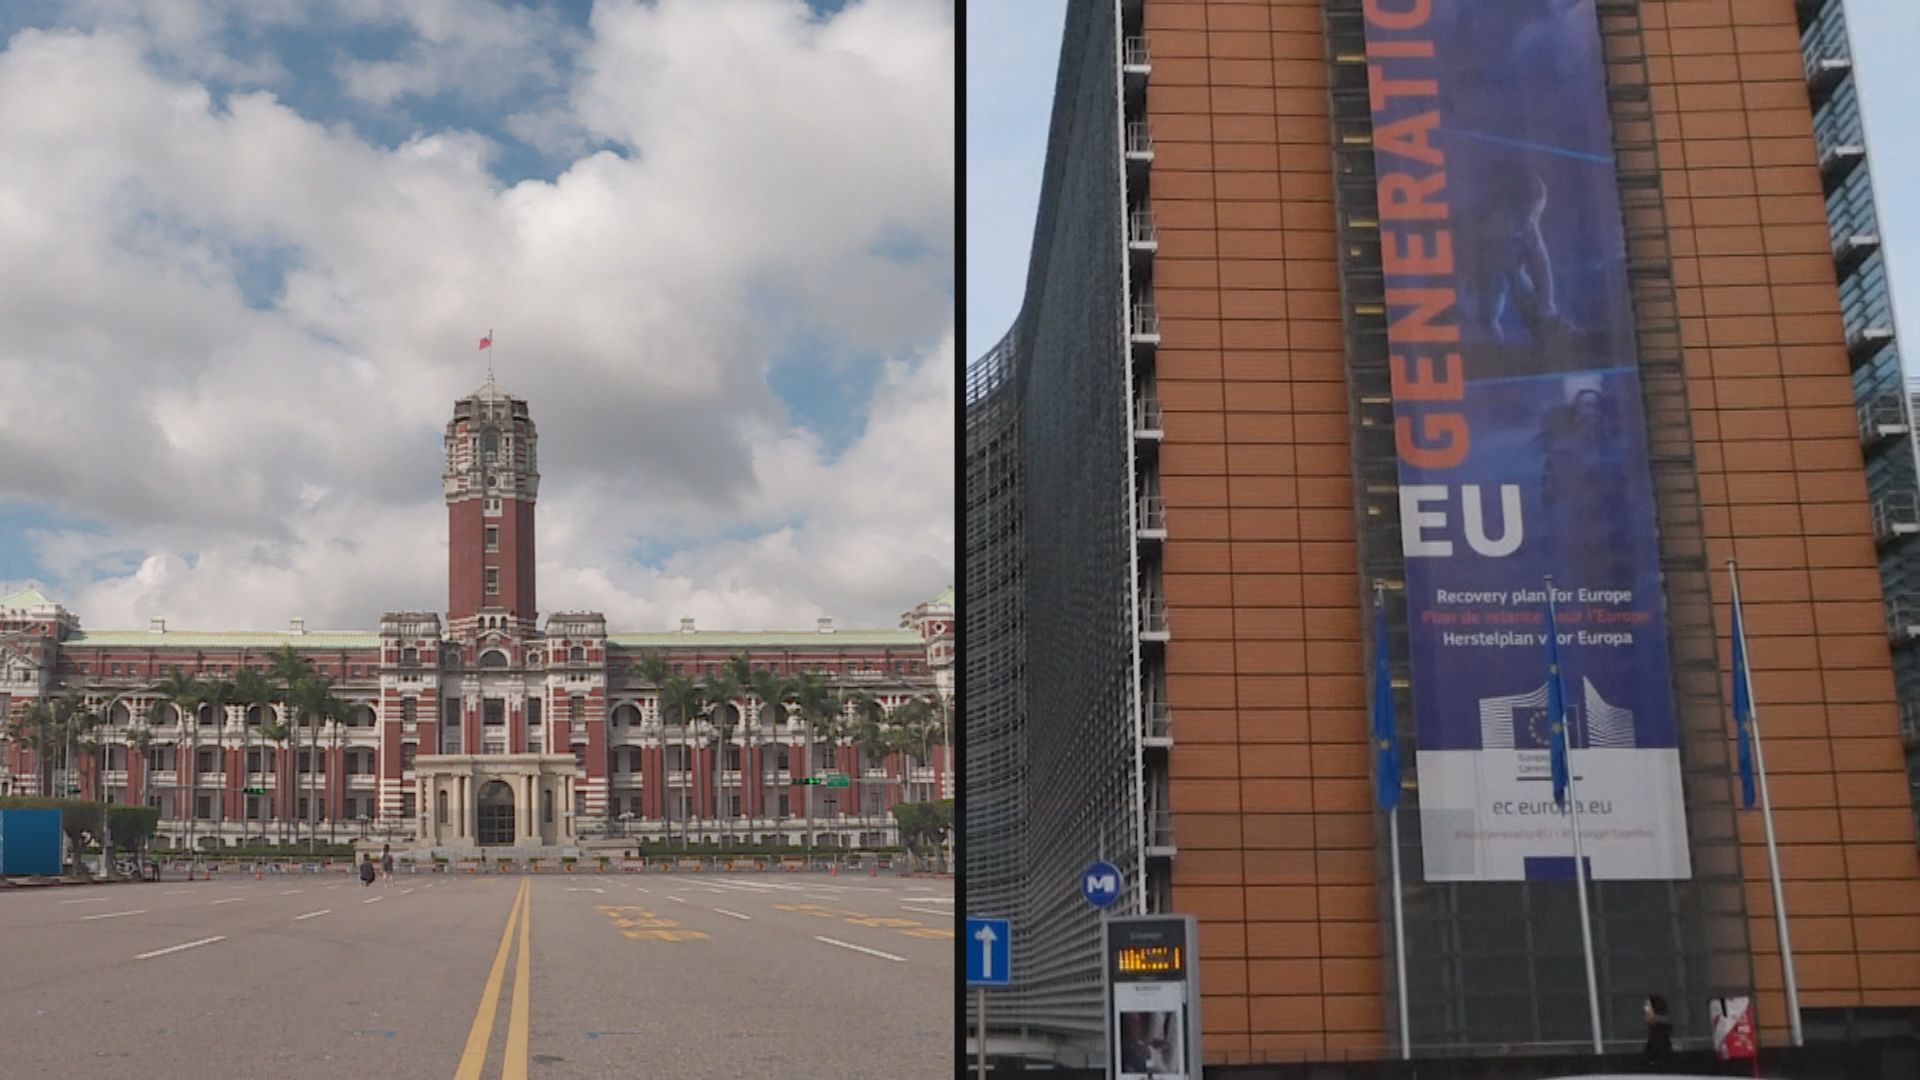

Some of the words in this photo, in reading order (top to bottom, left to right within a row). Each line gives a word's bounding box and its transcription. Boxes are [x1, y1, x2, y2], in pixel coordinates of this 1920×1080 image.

[1400, 484, 1524, 558] EU
[1437, 589, 1508, 605] Recovery
[1512, 588, 1547, 605] plan
[1551, 588, 1575, 602] for
[1578, 588, 1632, 605] Europe
[1443, 631, 1534, 648] Herstelplan
[1538, 632, 1574, 646] vor
[1578, 630, 1633, 648] Europa
[1087, 875, 1116, 894] M
